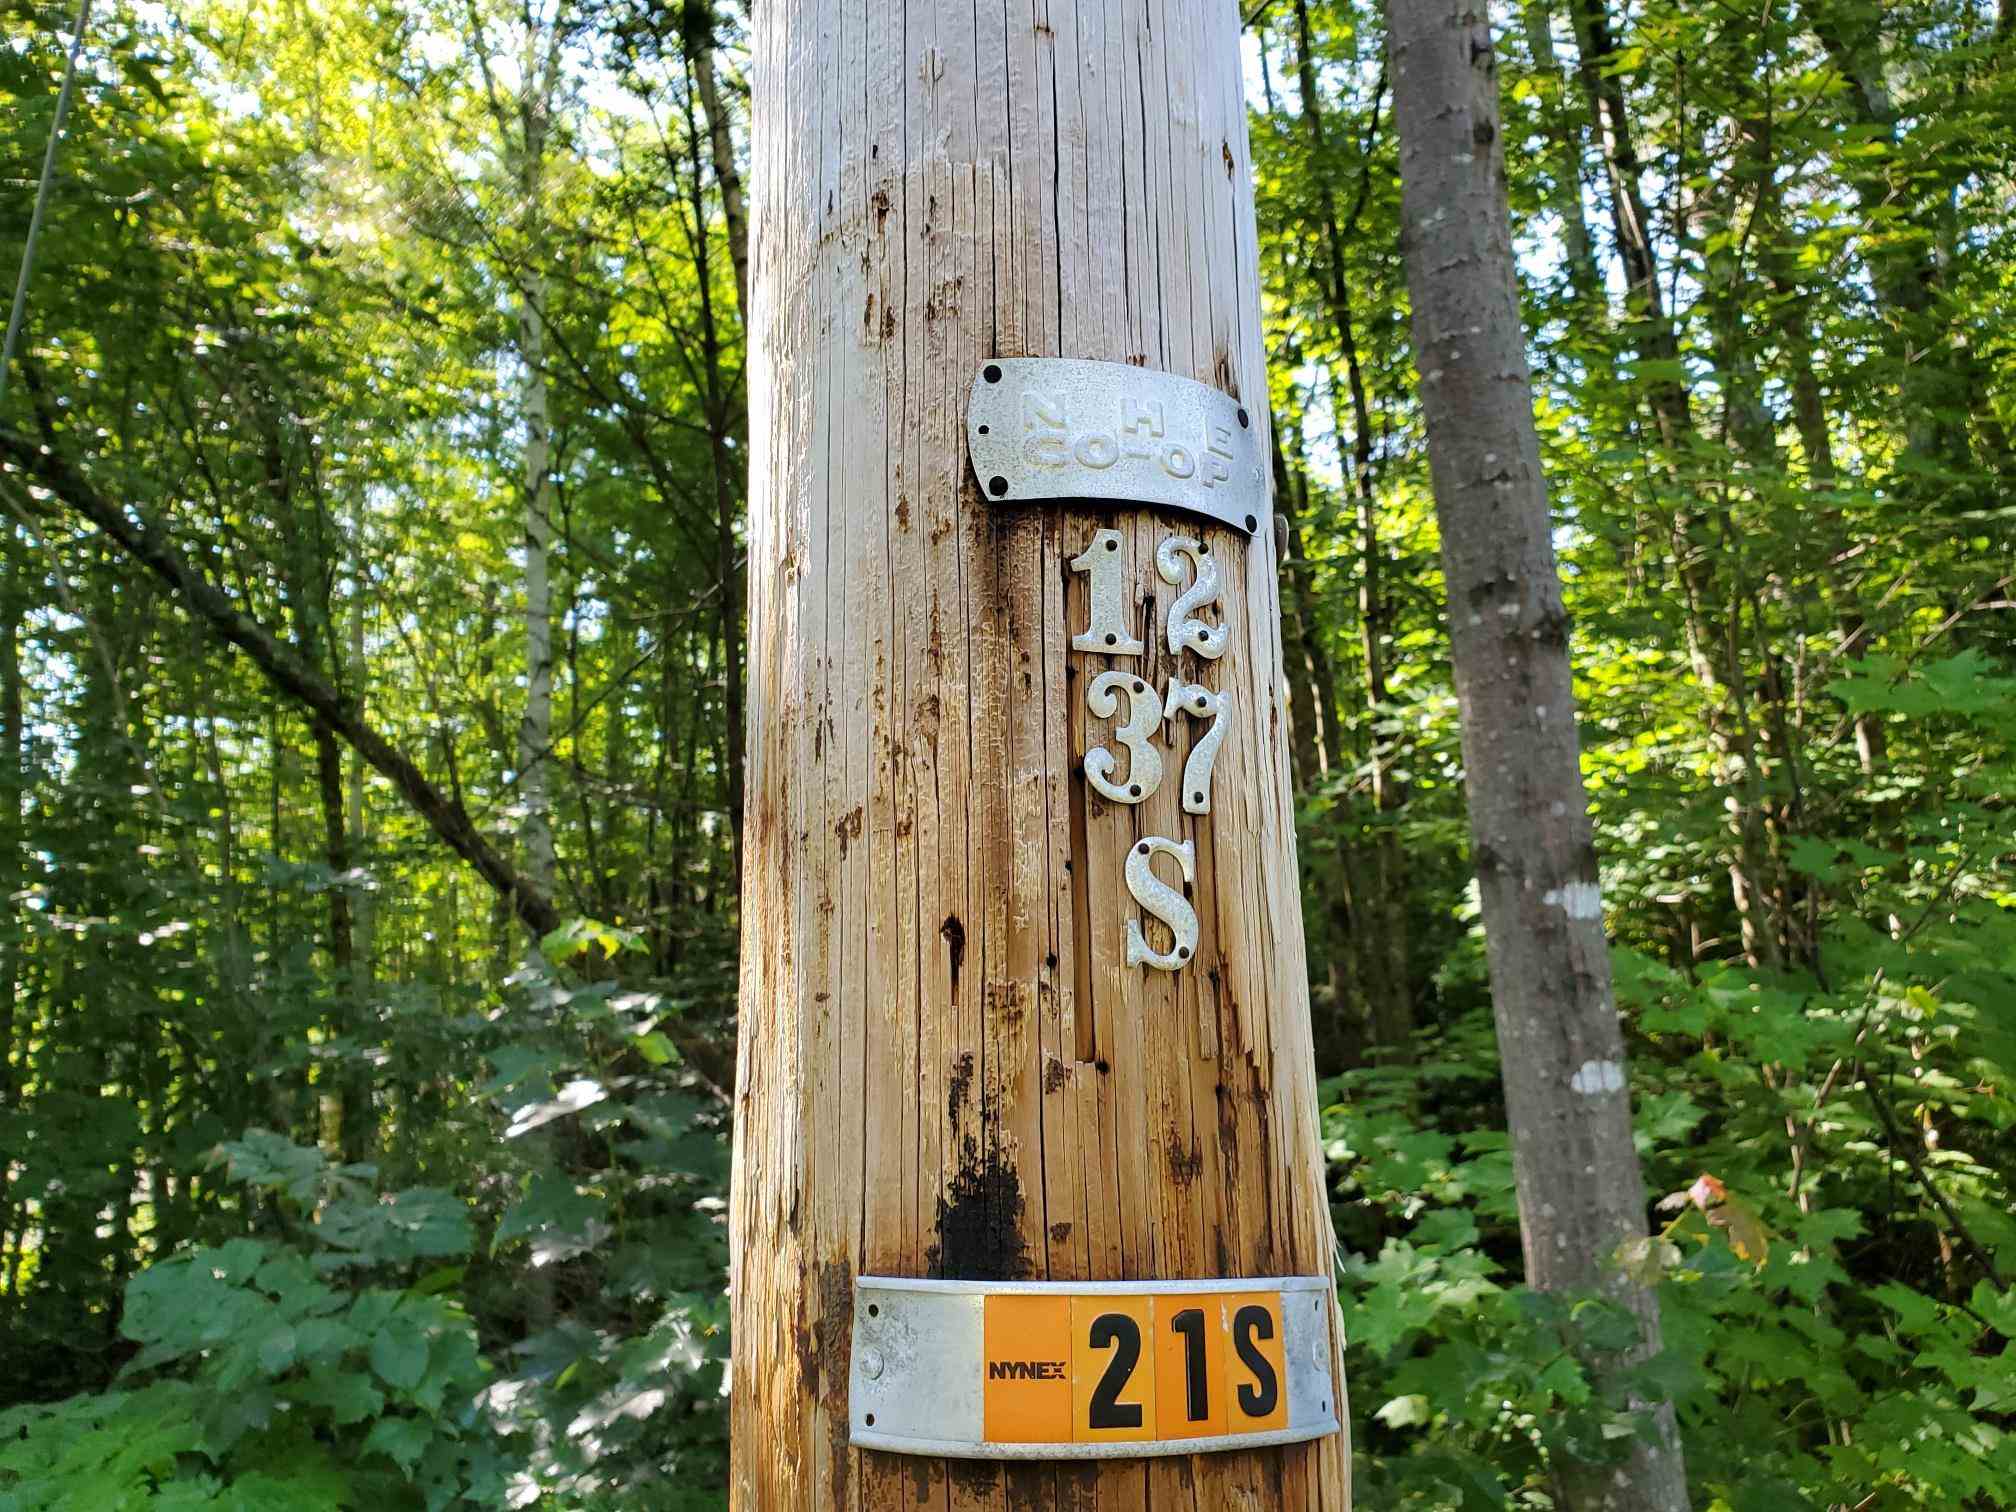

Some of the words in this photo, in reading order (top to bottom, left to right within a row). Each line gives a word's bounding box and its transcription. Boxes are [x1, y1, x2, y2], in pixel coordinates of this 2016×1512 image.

[1071, 528, 1230, 660] 12
[1084, 670, 1232, 815] 37
[1125, 836, 1199, 971] S
[989, 1361, 1066, 1379] NYNEX
